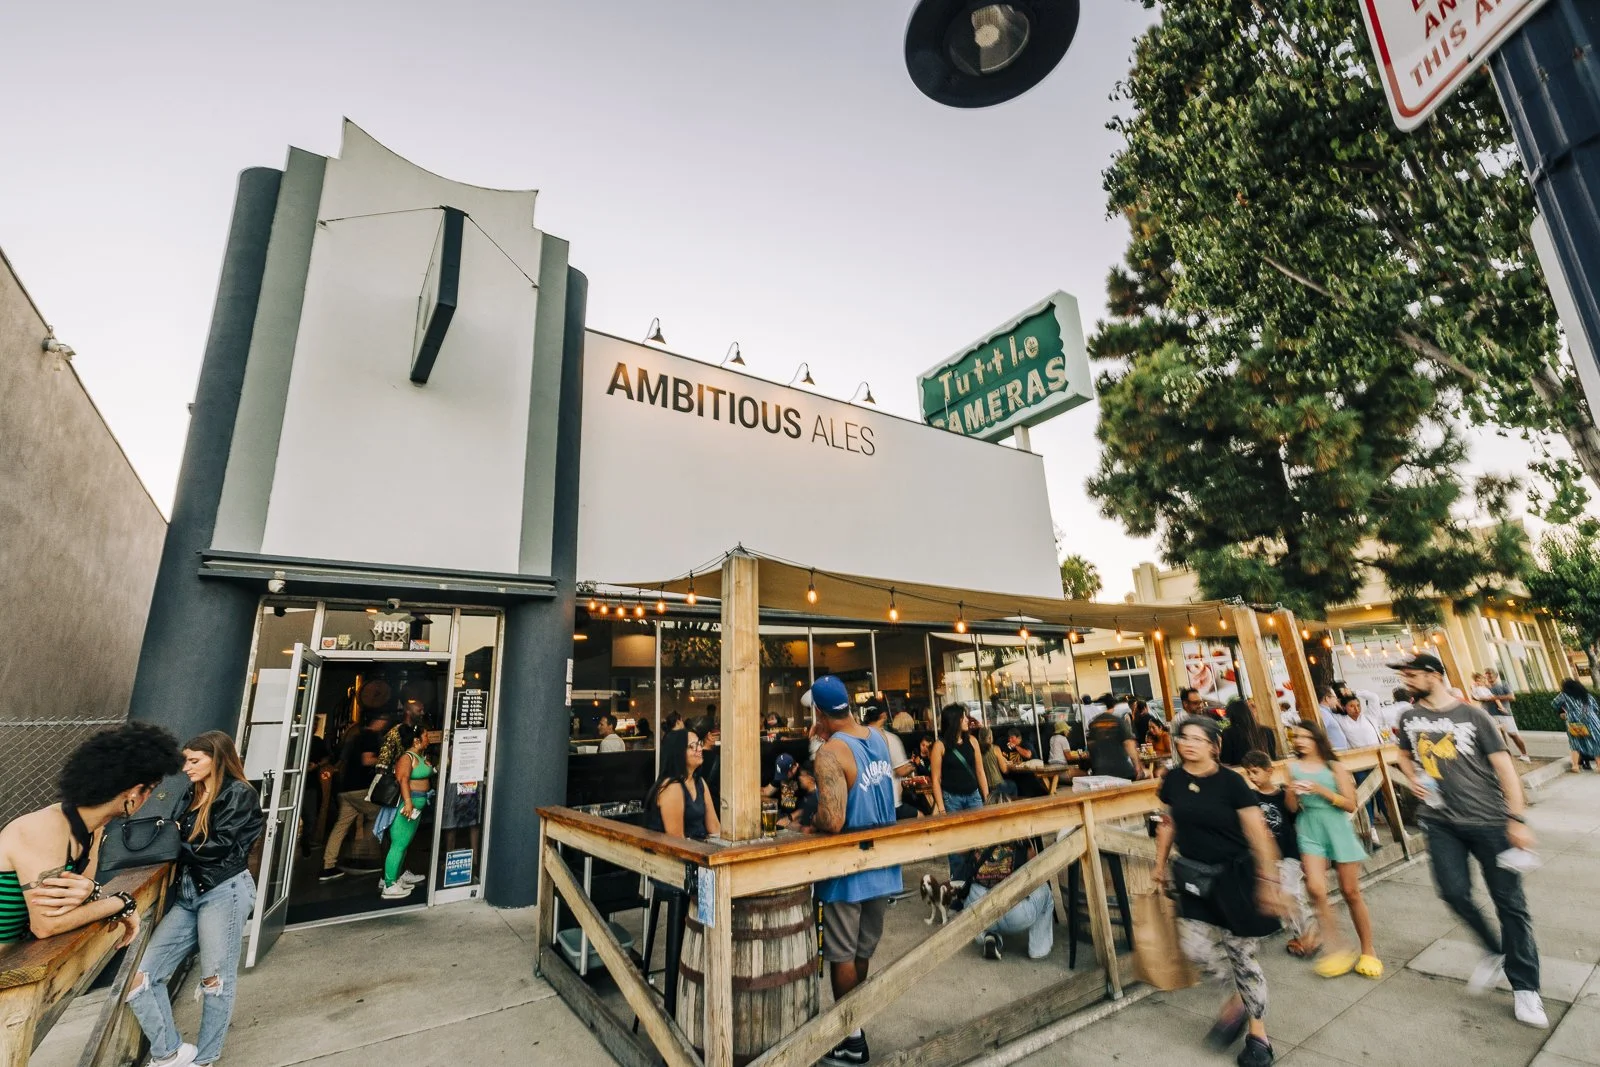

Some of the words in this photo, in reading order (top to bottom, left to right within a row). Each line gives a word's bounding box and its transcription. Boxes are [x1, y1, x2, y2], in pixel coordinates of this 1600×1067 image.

[1409, 19, 1468, 87] THIS
[938, 335, 1039, 402] Tuttle
[606, 361, 802, 440] AMBITIOUS
[811, 414, 876, 457] ALES
[373, 620, 408, 634] 4019
